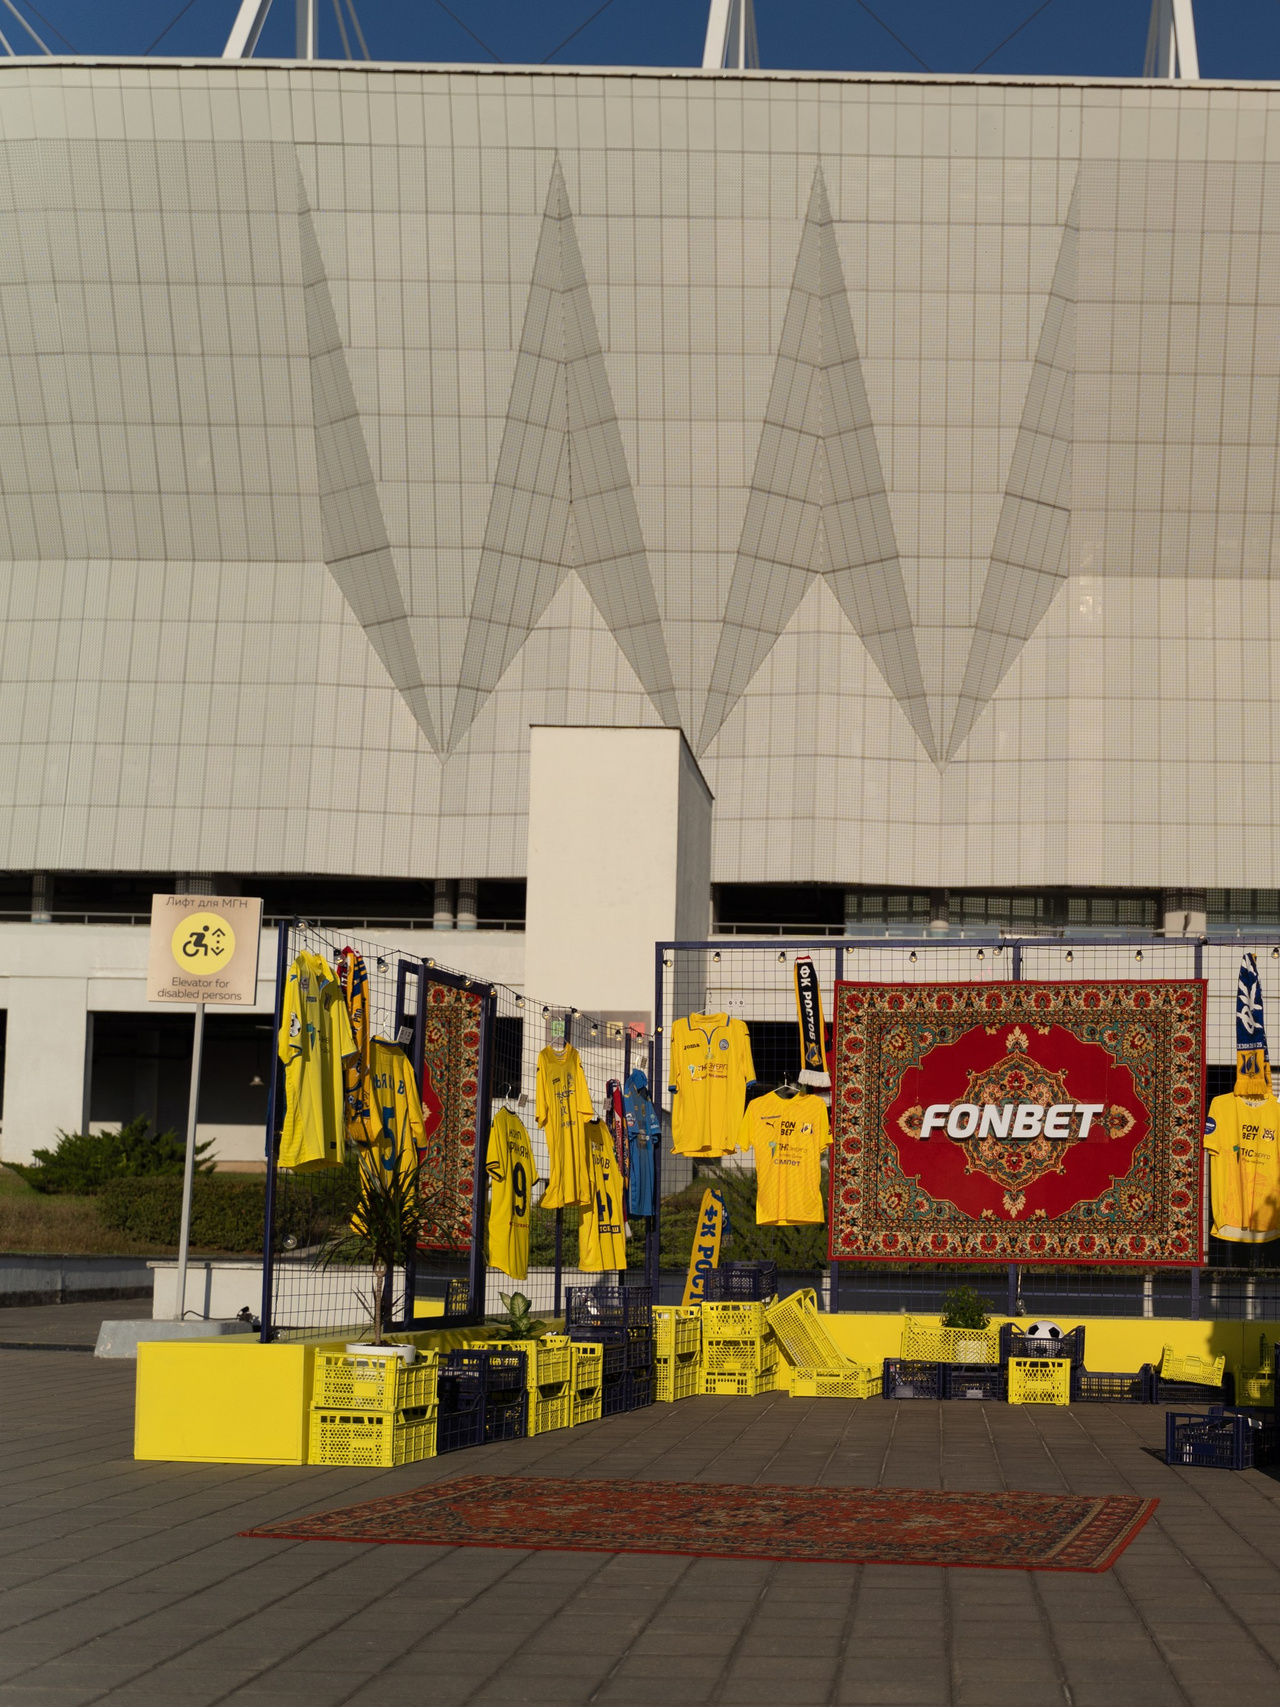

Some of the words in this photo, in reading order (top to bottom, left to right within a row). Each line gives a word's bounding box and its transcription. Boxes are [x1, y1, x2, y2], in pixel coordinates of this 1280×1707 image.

[166, 897, 195, 908] Лифт
[198, 900, 219, 908] для
[222, 899, 248, 908] МГН
[172, 977, 213, 987] Elevator
[215, 978, 230, 988] for
[799, 965, 811, 987] ФК
[157, 989, 200, 999] disabled
[201, 993, 242, 1001] persons
[803, 991, 816, 1041] РОСТОВ
[919, 1103, 1105, 1139] FONBET
[1242, 1124, 1260, 1133] FON
[700, 1205, 718, 1237] ФК
[688, 1244, 715, 1306] РОСТ
